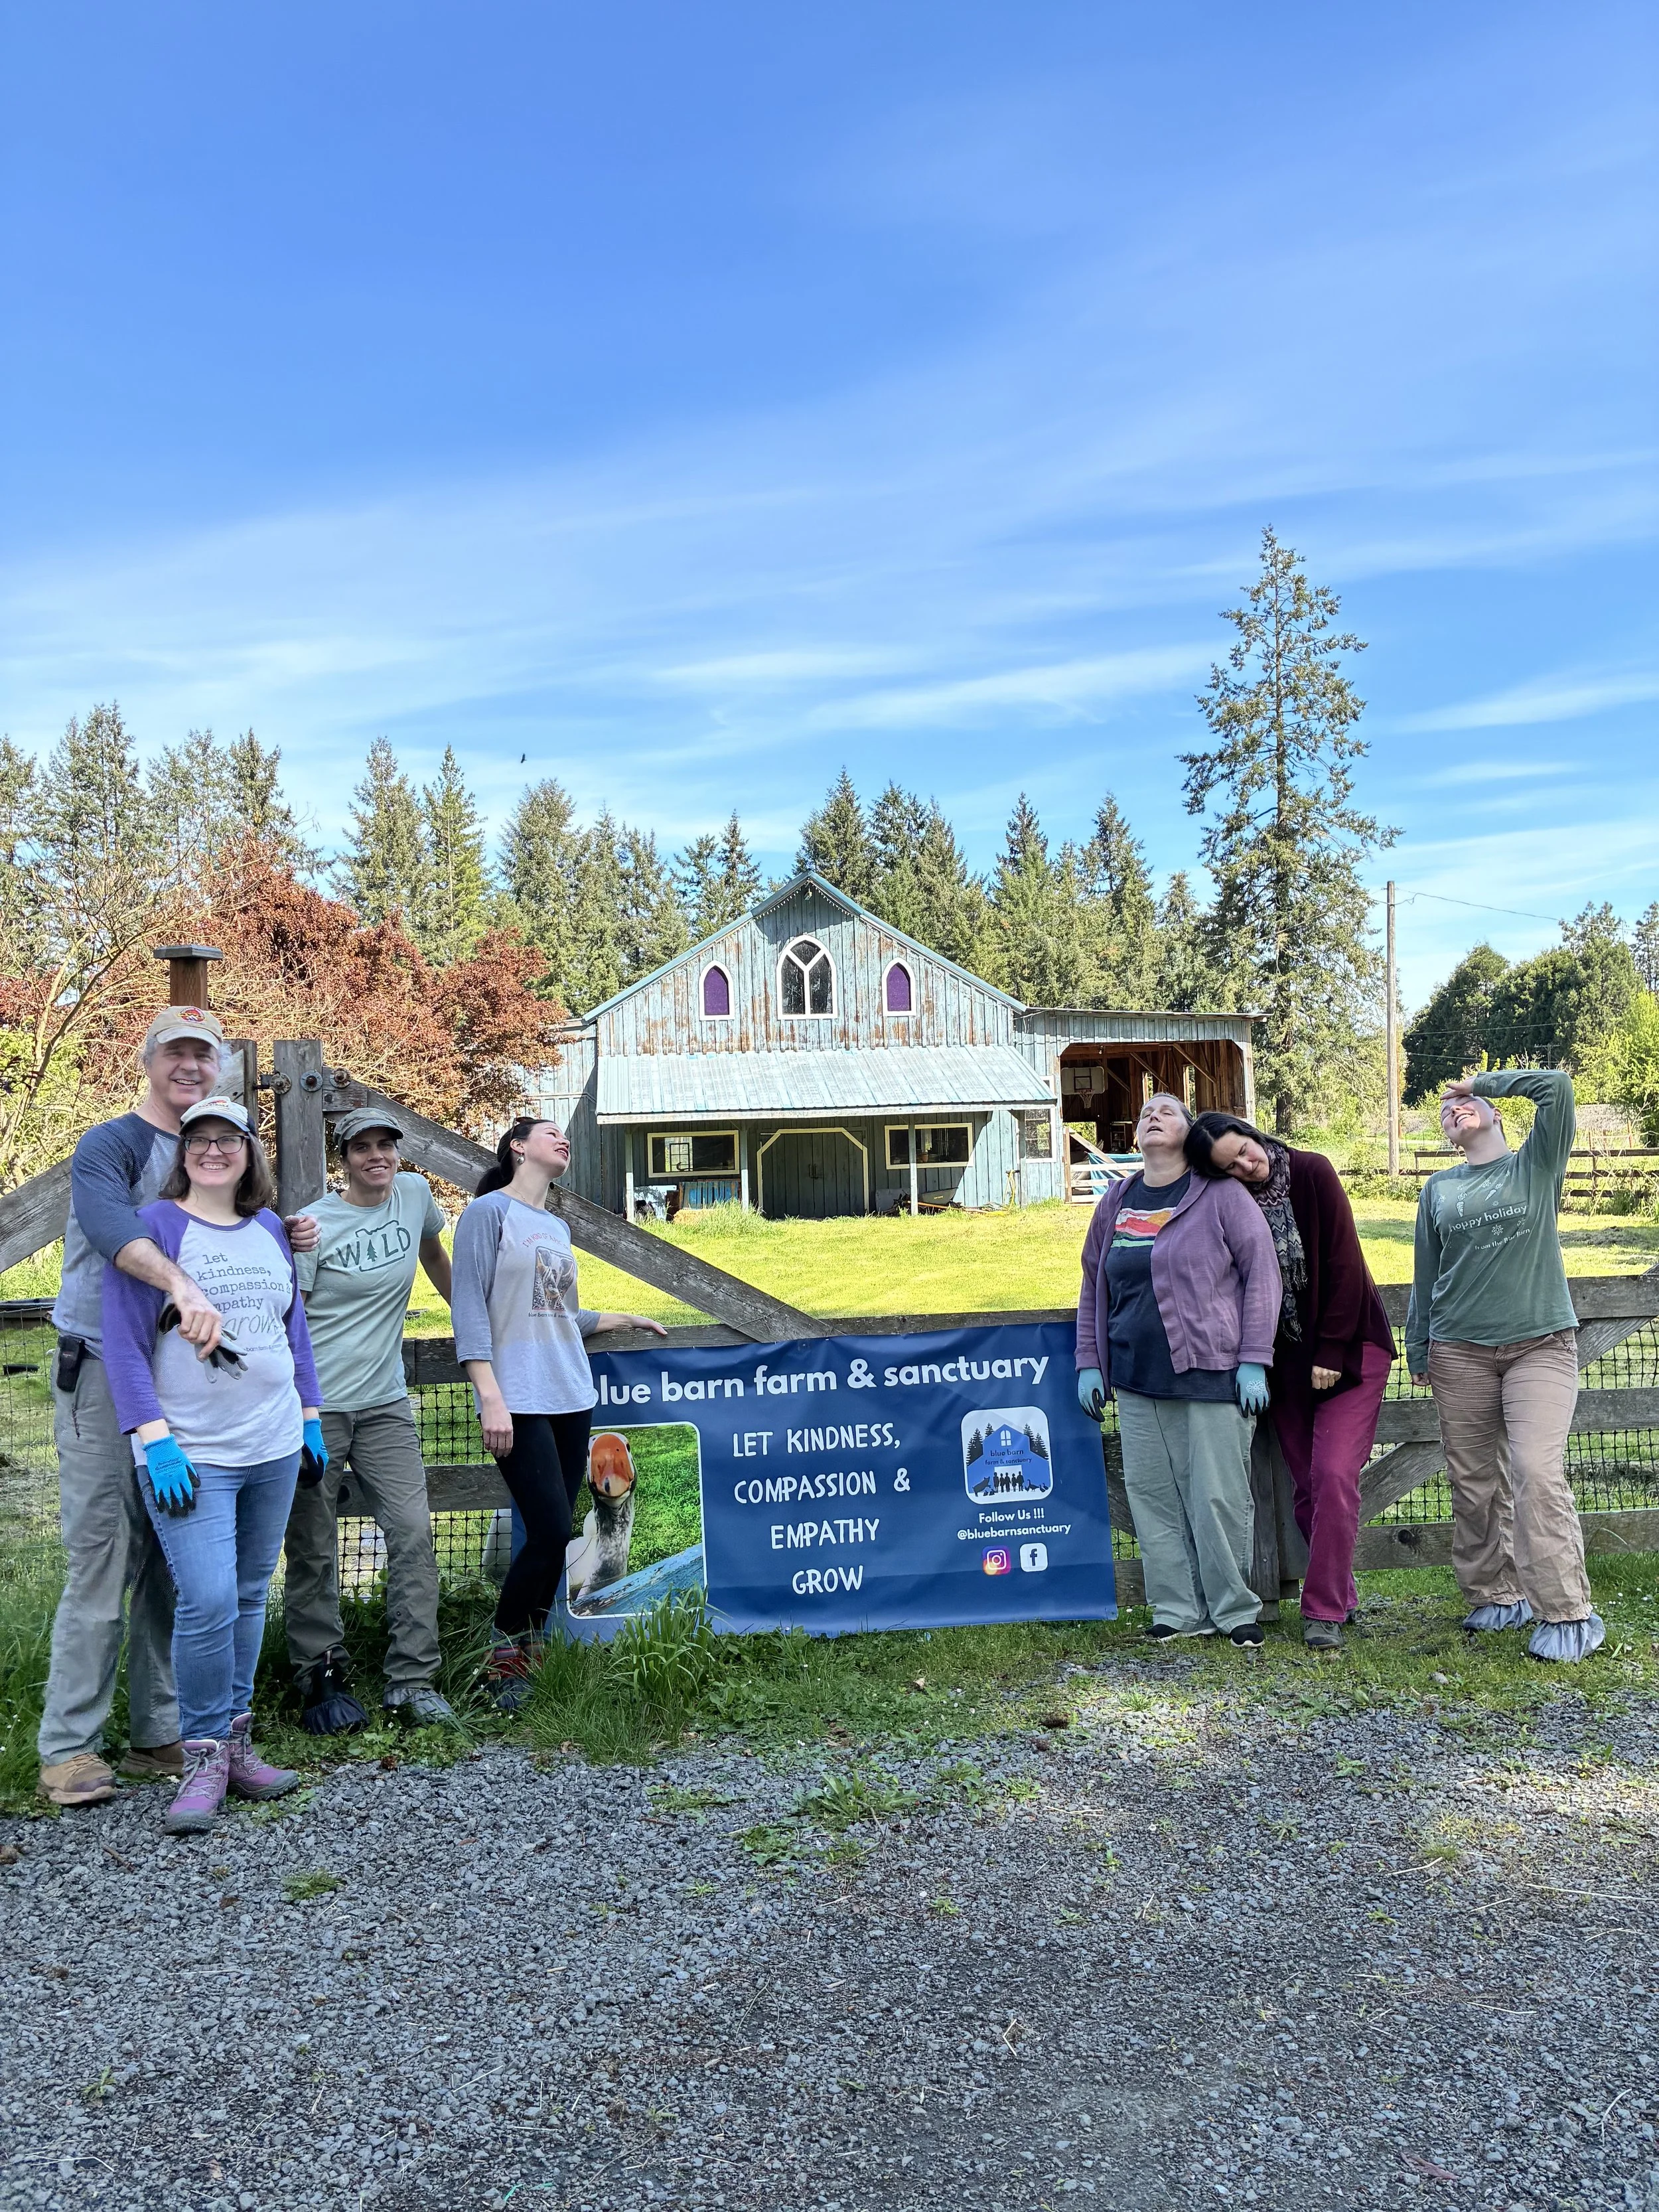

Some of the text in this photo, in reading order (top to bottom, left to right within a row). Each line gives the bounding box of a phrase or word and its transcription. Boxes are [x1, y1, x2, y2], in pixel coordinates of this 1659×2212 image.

[1484, 1205, 1527, 1221] holiday
[202, 1252, 228, 1265] let
[196, 1266, 271, 1282] kindness,
[213, 1296, 264, 1313] mpathy
[593, 1356, 1050, 1406] lue barn farm & sanctuary
[733, 1422, 901, 1457] LET KINDNESS,
[734, 1467, 910, 1504] COMPASSION &
[979, 1507, 1045, 1524] Follow Us !!!
[771, 1518, 880, 1550] EMPATHY
[957, 1524, 1072, 1540] @bluebarnsanctuary
[792, 1565, 863, 1594] GROW
